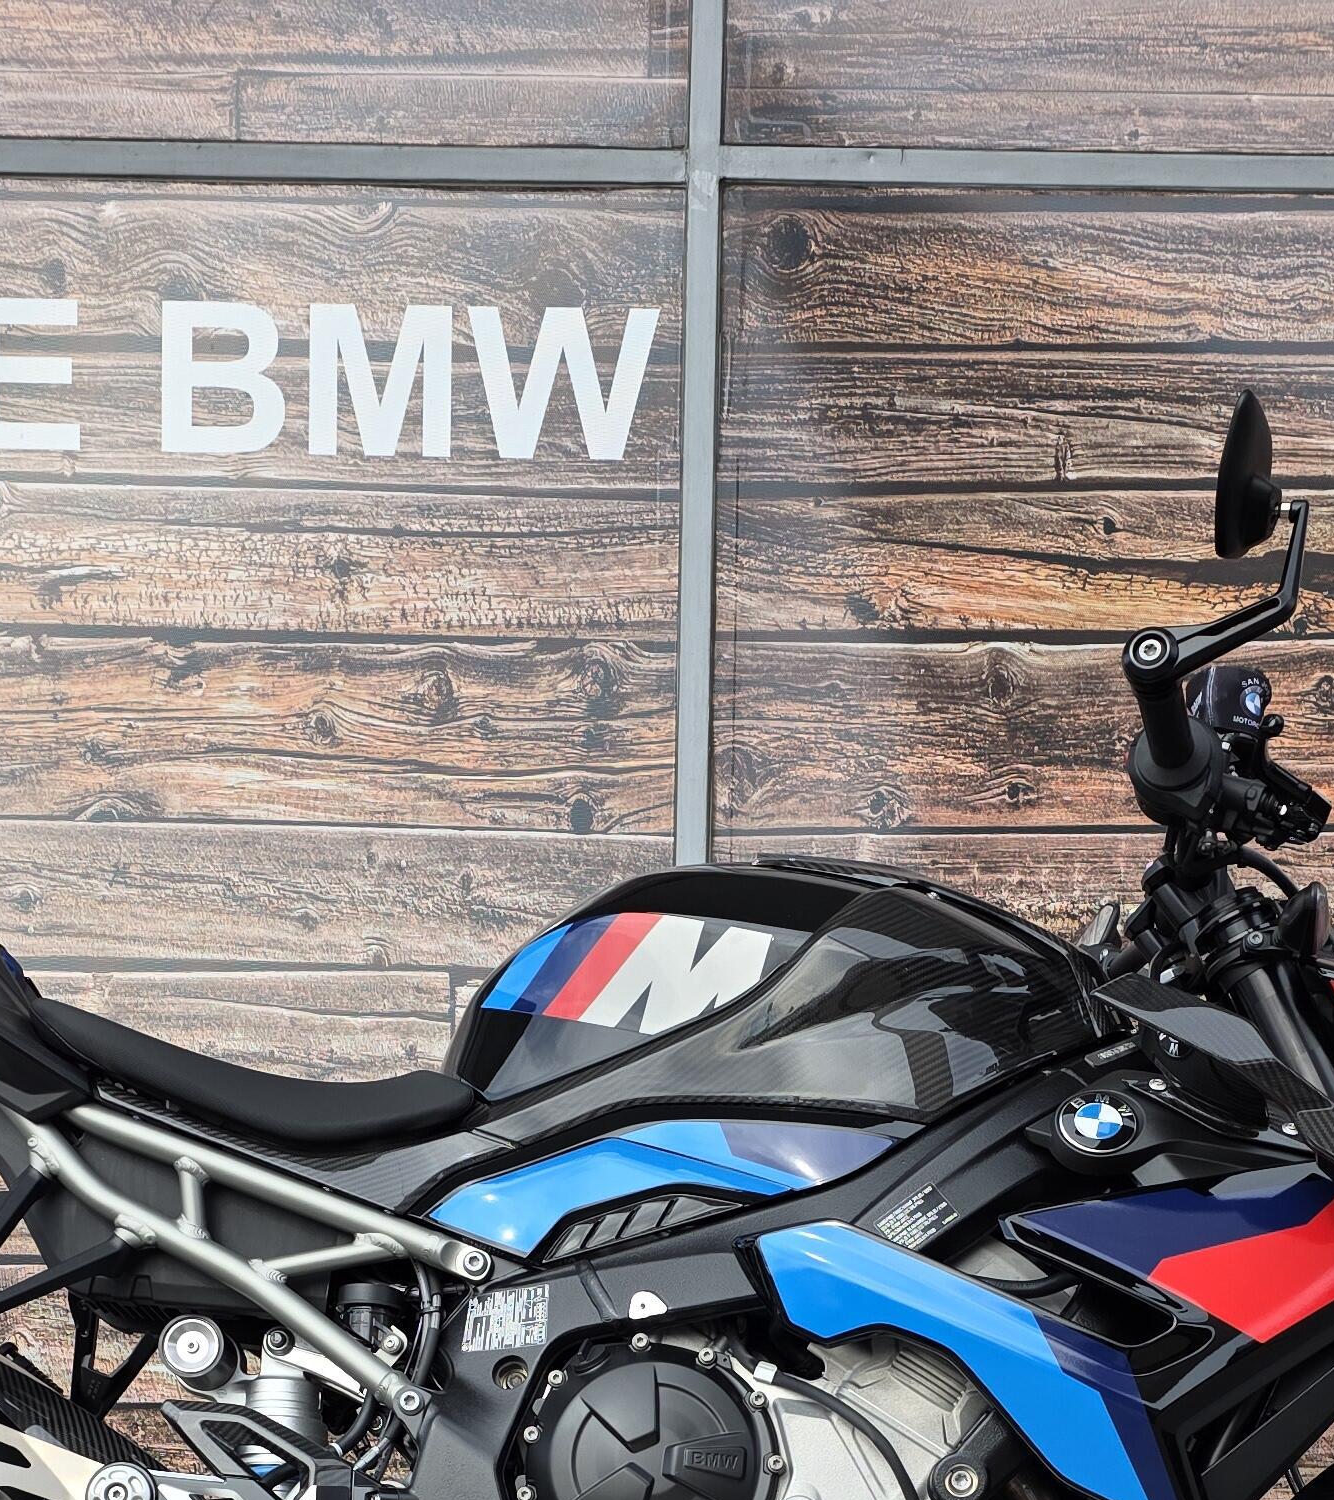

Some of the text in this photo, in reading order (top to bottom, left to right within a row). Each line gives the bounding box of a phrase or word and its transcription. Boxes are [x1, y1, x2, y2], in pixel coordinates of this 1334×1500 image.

[159, 299, 662, 461] BMW
[1069, 1093, 1134, 1118] BMW
[691, 1451, 739, 1471] BMW
